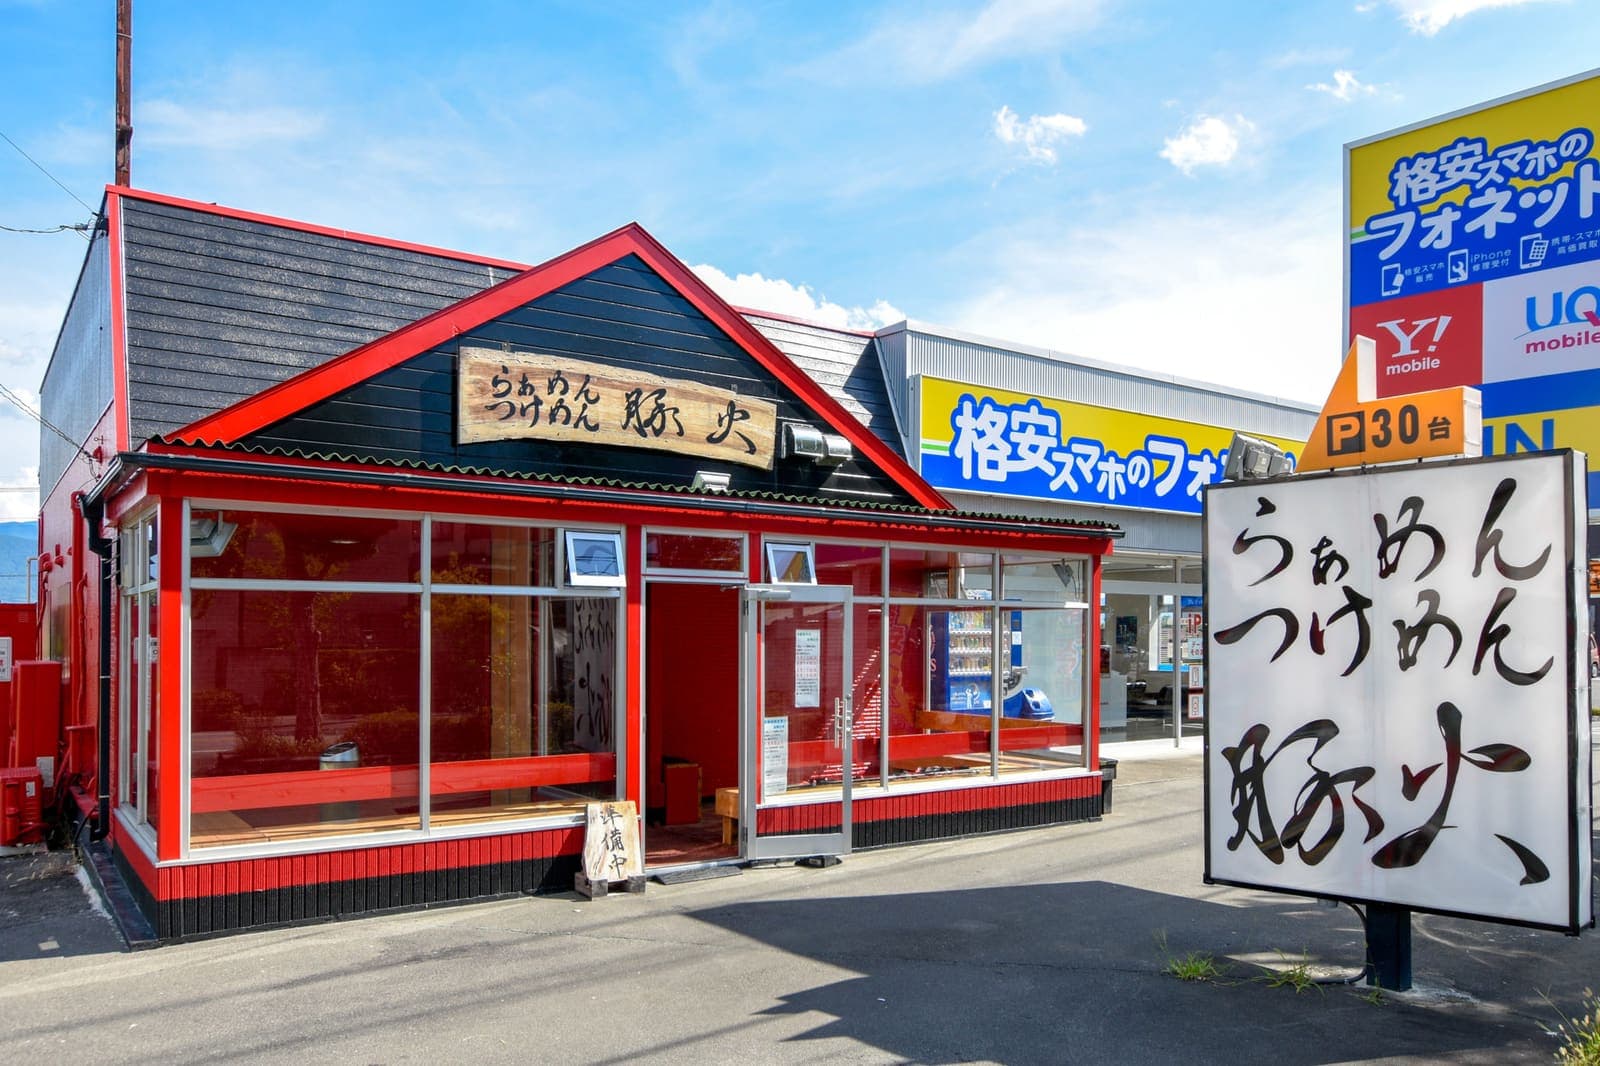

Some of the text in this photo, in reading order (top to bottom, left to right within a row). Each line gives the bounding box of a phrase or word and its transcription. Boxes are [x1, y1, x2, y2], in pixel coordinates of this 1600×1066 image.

[1392, 133, 1588, 206] 格安スマホの
[1369, 165, 1600, 260] フォネット
[1404, 262, 1445, 277] 格安スマホ
[1470, 249, 1512, 263] iPhone
[1526, 285, 1600, 332] UQ
[1376, 315, 1452, 358] Y!
[1526, 330, 1600, 354] mobile
[491, 366, 600, 405] らぁめん
[1386, 357, 1441, 375] mobile
[485, 395, 600, 433] つけめん
[954, 399, 1228, 502] 格安スマホのフォ
[1232, 478, 1552, 586] らぁめん
[1213, 585, 1555, 686] つけめん
